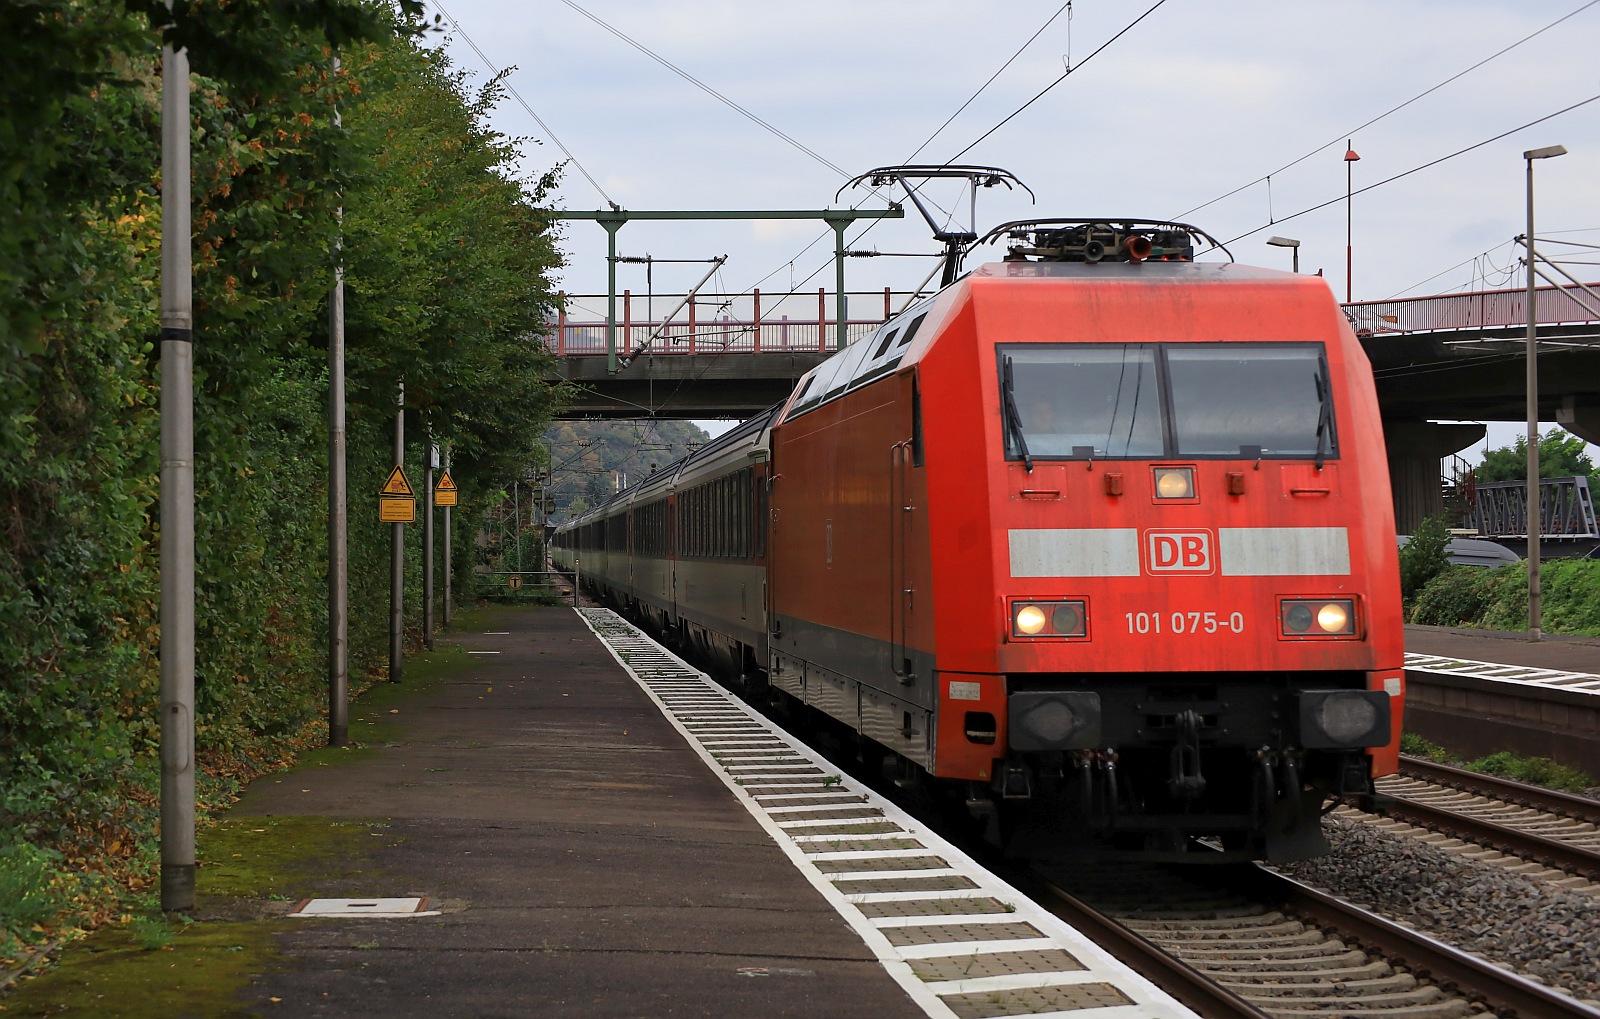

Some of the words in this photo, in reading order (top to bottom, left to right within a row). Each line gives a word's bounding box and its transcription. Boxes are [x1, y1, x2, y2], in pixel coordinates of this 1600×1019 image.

[1154, 536, 1206, 567] DB
[1125, 612, 1161, 634] 101
[1171, 612, 1244, 634] 075-0
